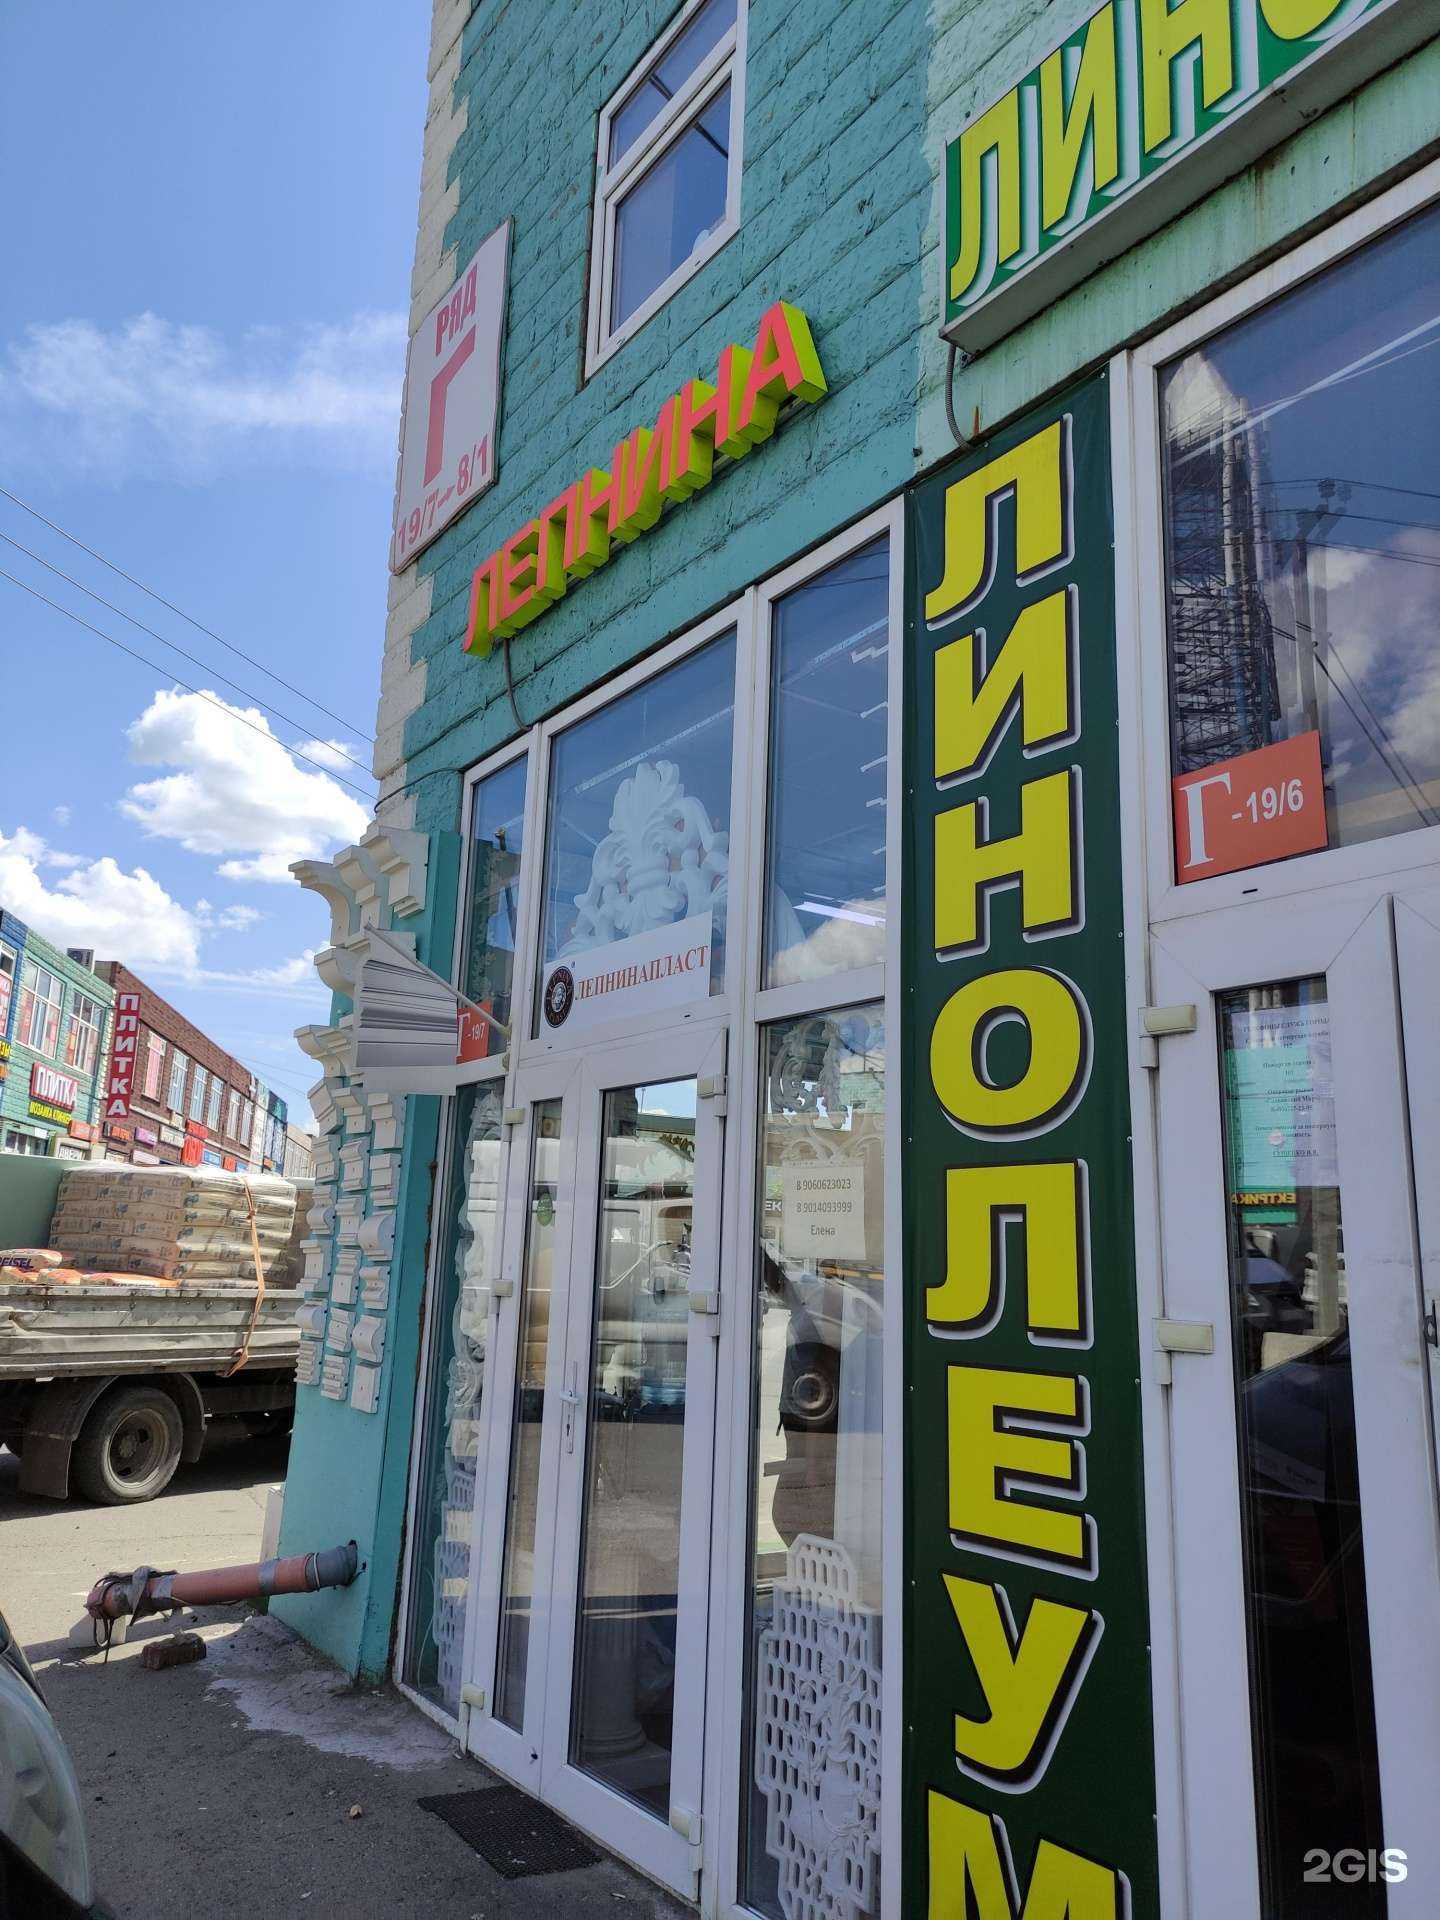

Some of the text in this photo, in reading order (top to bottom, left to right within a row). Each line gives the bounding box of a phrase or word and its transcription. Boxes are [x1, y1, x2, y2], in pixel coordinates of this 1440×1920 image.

[949, 0, 1362, 302] ЛИН
[435, 263, 478, 357] РЯД
[423, 323, 477, 489] Г
[463, 301, 828, 661] ЛЕПНИНА
[575, 946, 708, 1001] ЛЕПНИНАПЛАСТ
[36, 1065, 78, 1107] ПЛИТКА
[107, 994, 139, 1116] ПЛИТКА
[924, 412, 1132, 1920] ЛИНОЛЕУМ
[810, 1224, 836, 1236] Елена
